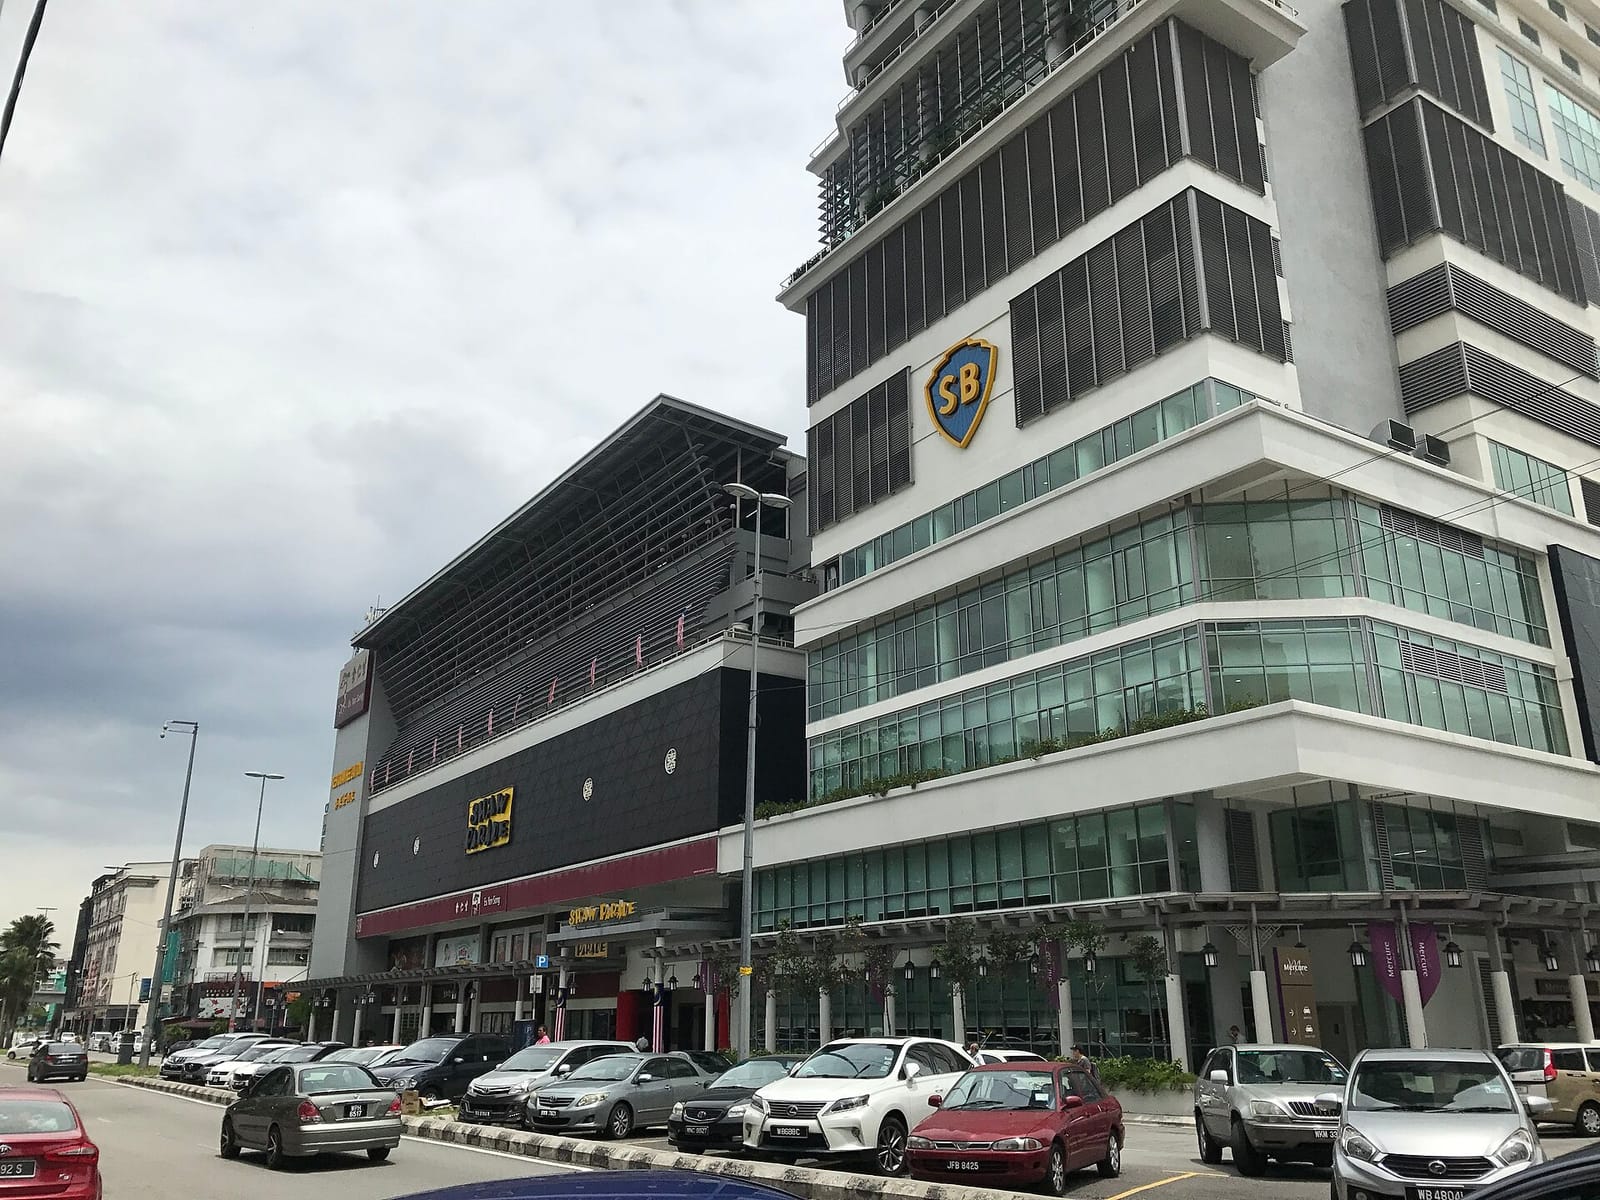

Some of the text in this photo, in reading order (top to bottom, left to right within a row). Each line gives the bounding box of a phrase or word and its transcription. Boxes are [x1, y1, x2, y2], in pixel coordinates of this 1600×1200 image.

[939, 362, 981, 416] SB
[569, 900, 637, 925] SHAW PARADE
[538, 956, 546, 967] P
[1384, 941, 1395, 977] Mercure
[1419, 942, 1429, 977] Mercure
[1283, 963, 1308, 972] Mercure
[15, 1164, 23, 1174] S
[947, 1161, 979, 1170] JFB 8425
[1417, 1190, 1433, 1200] WB
